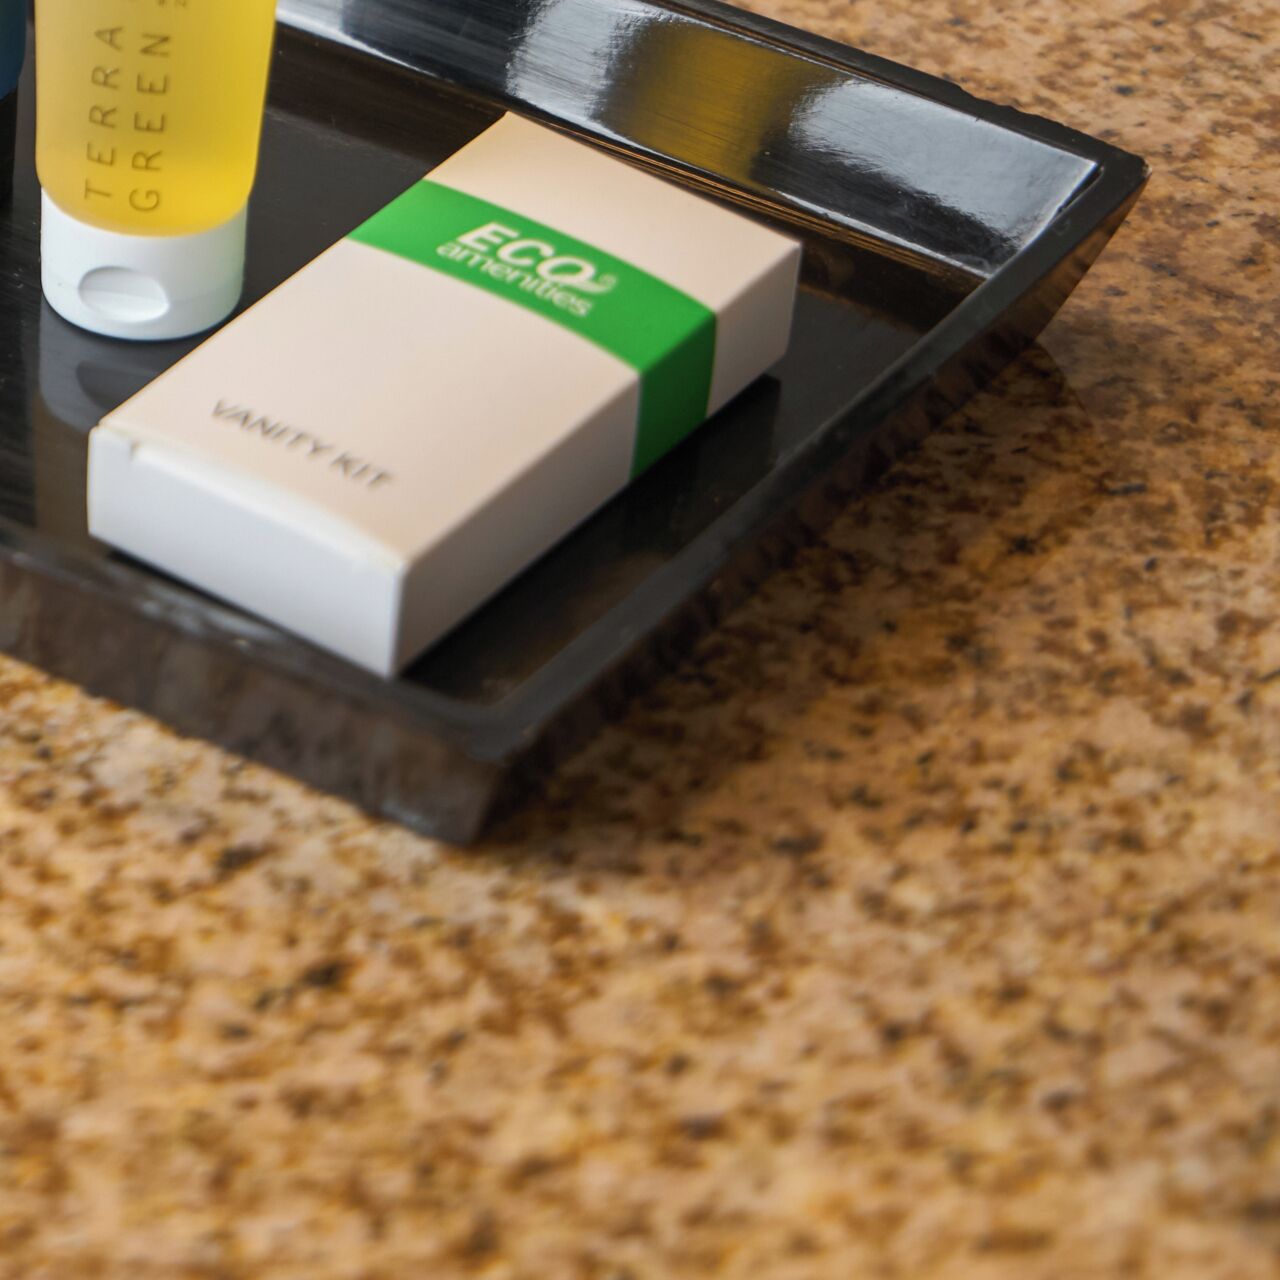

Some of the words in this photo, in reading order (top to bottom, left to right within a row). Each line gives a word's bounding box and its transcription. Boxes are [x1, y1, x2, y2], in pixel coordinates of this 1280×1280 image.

[84, 25, 124, 201] TERRA
[129, 33, 171, 213] GREEN
[436, 242, 593, 317] amenities
[212, 399, 335, 460] VANITY
[330, 452, 397, 489] KIT
